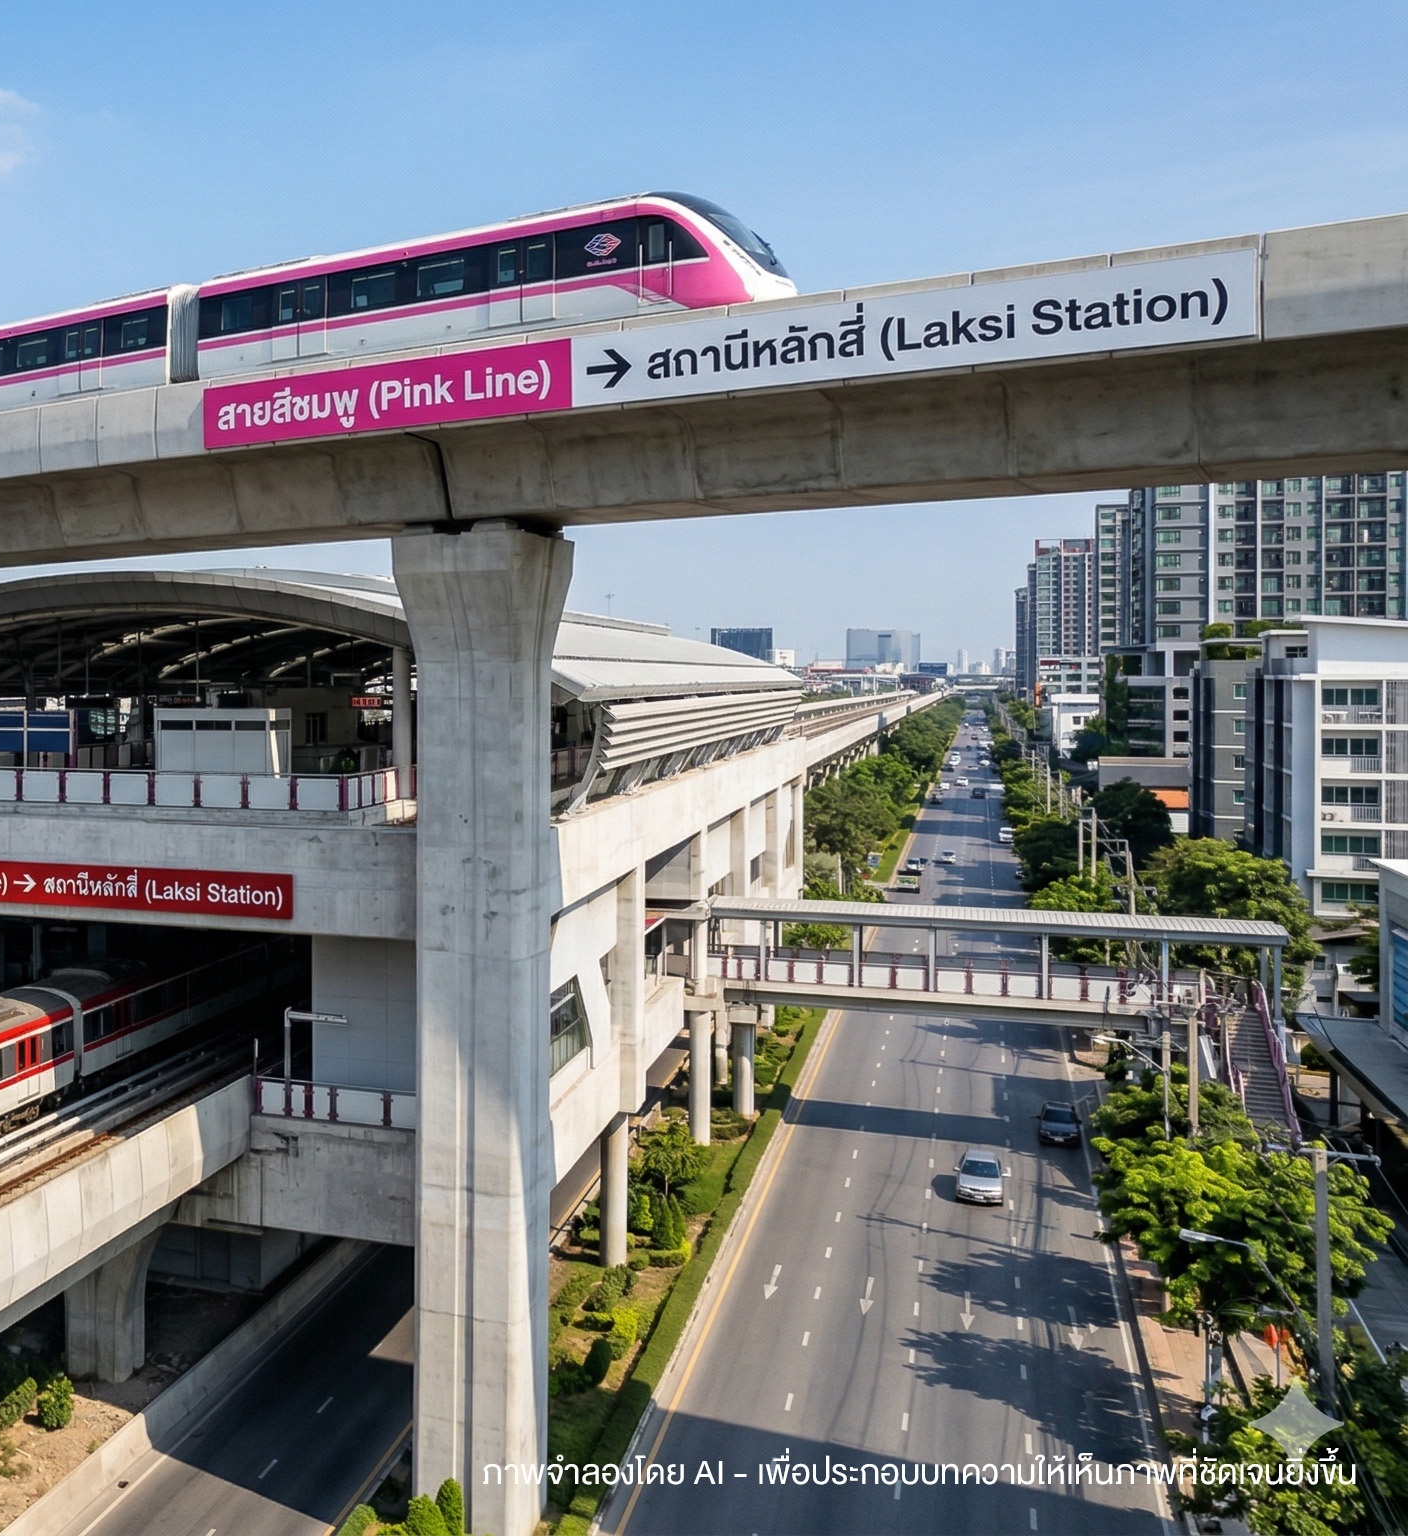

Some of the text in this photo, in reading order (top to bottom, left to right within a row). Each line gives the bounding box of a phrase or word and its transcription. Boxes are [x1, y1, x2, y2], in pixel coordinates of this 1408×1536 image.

[647, 277, 1228, 380] สถานีหลักสี่ (Laksi Station)
[217, 360, 551, 428] สายสีชมพู (Pink Line)
[43, 869, 138, 898] สถานีหลักสี่
[145, 880, 201, 905] (Laksi
[207, 884, 283, 911] Station)
